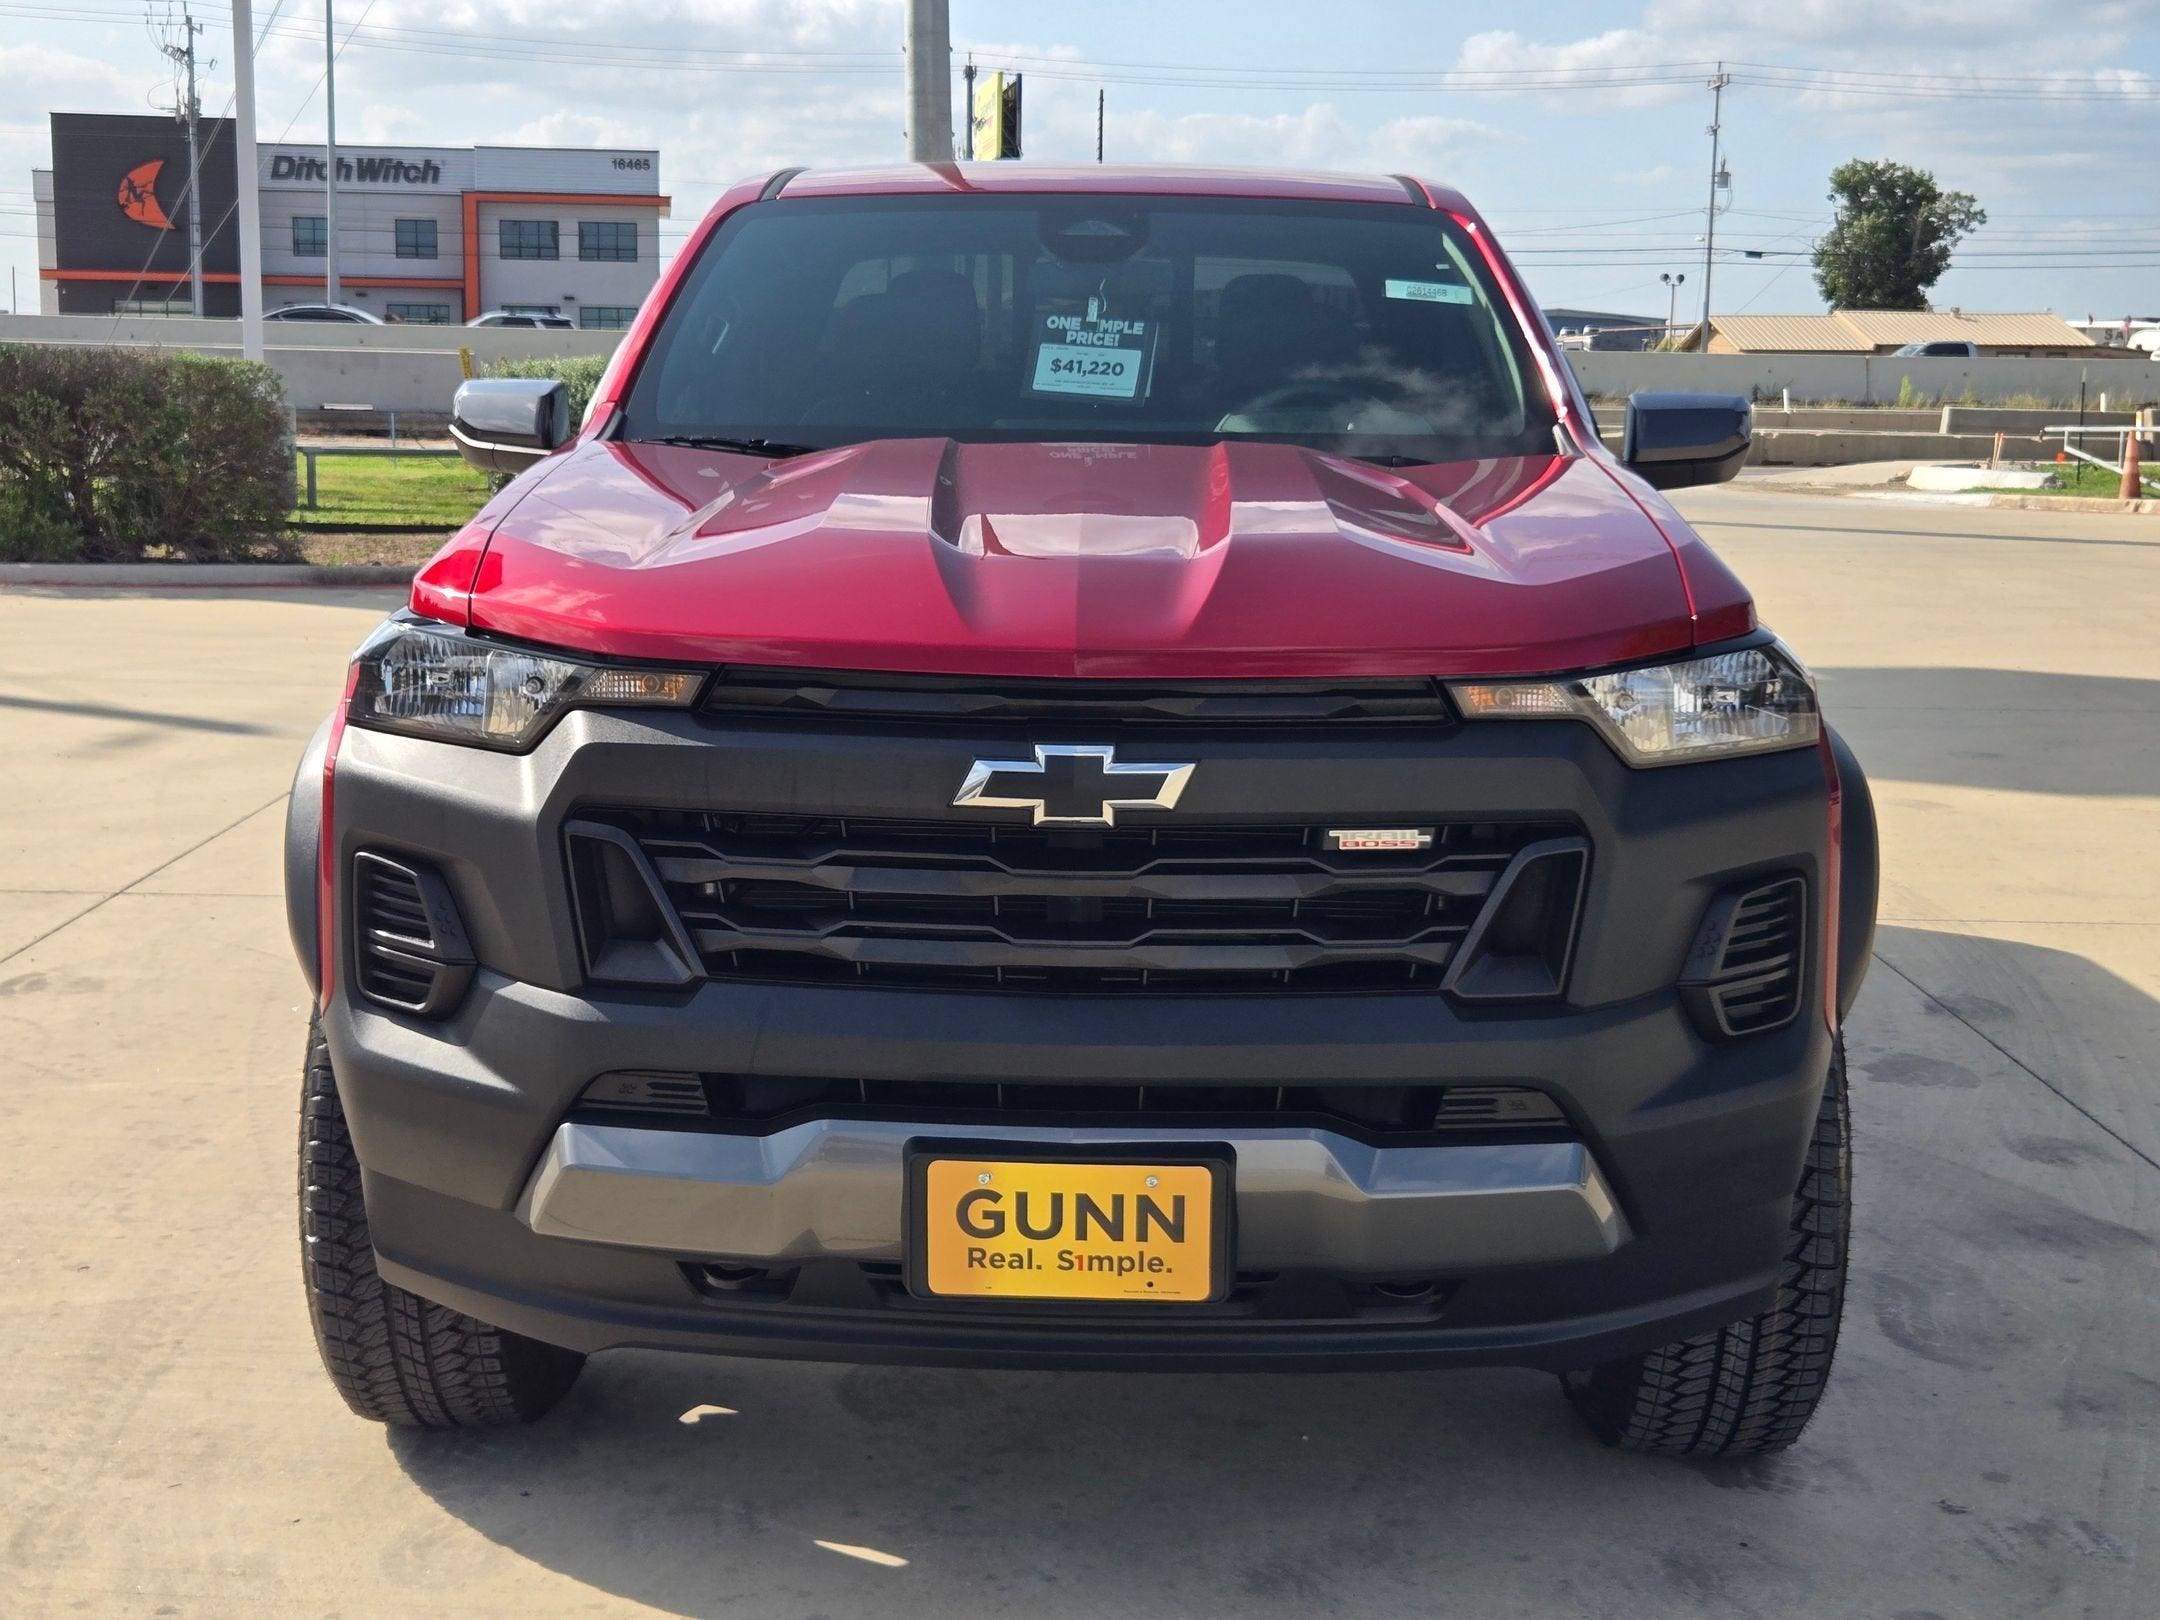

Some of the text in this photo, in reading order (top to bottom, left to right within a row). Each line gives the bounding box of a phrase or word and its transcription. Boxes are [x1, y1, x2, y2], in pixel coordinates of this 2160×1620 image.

[271, 155, 441, 184] Ditch Witch
[611, 158, 650, 171] 16465
[1046, 316, 1145, 335] ONE MPLE
[1065, 331, 1120, 347] PRICE!
[1050, 358, 1125, 377] $41,220
[1341, 840, 1417, 848] BOSS
[955, 1188, 1186, 1243] GUNN
[967, 1246, 1042, 1270] Real.
